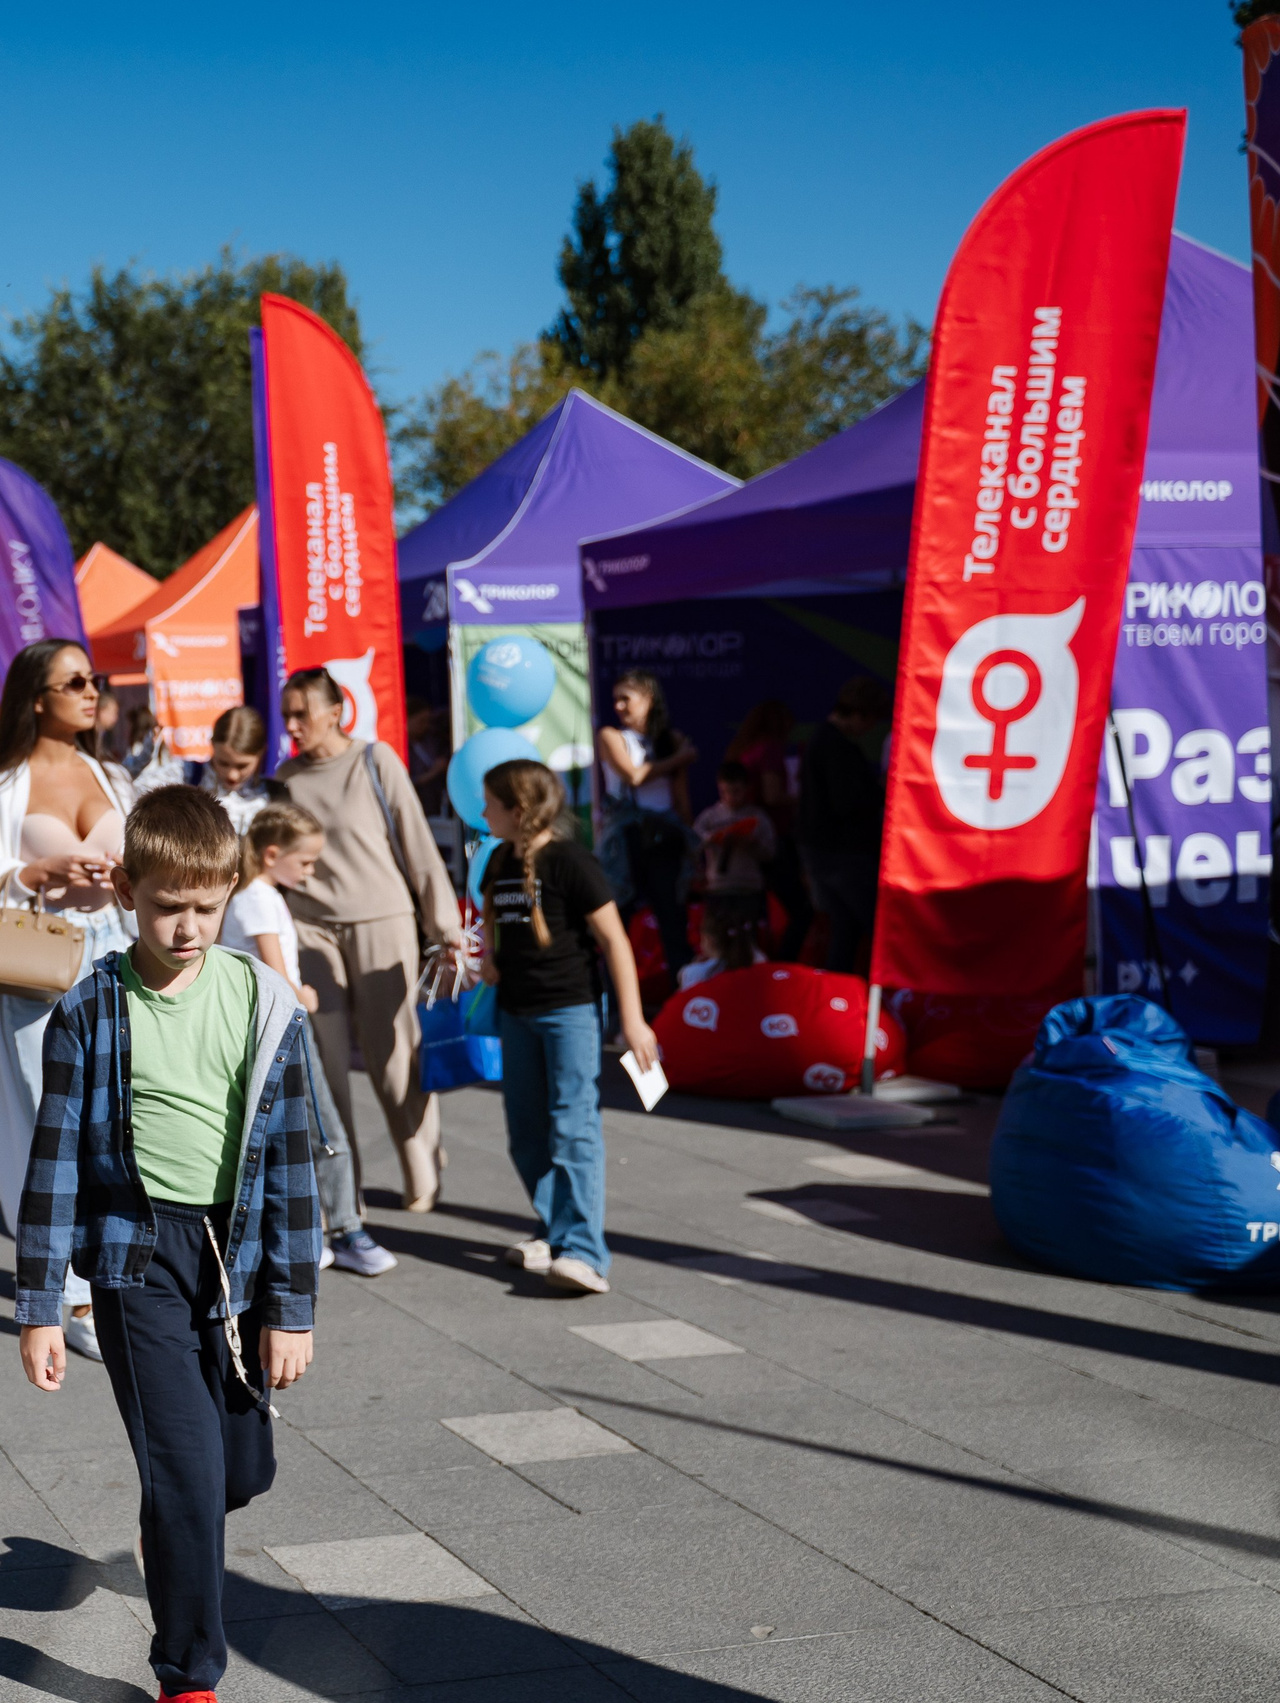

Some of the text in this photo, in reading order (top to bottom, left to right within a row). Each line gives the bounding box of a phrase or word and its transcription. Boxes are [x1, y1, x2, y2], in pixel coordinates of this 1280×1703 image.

[962, 365, 1018, 582] Телеканал
[1007, 306, 1063, 530] с большим
[1041, 375, 1087, 553] сердцем
[304, 482, 328, 638] Телеканал
[323, 441, 344, 579] большим
[340, 493, 364, 618] сердцем
[478, 583, 560, 601] ТРИКОЛОР
[1246, 1222, 1280, 1243] ТР
